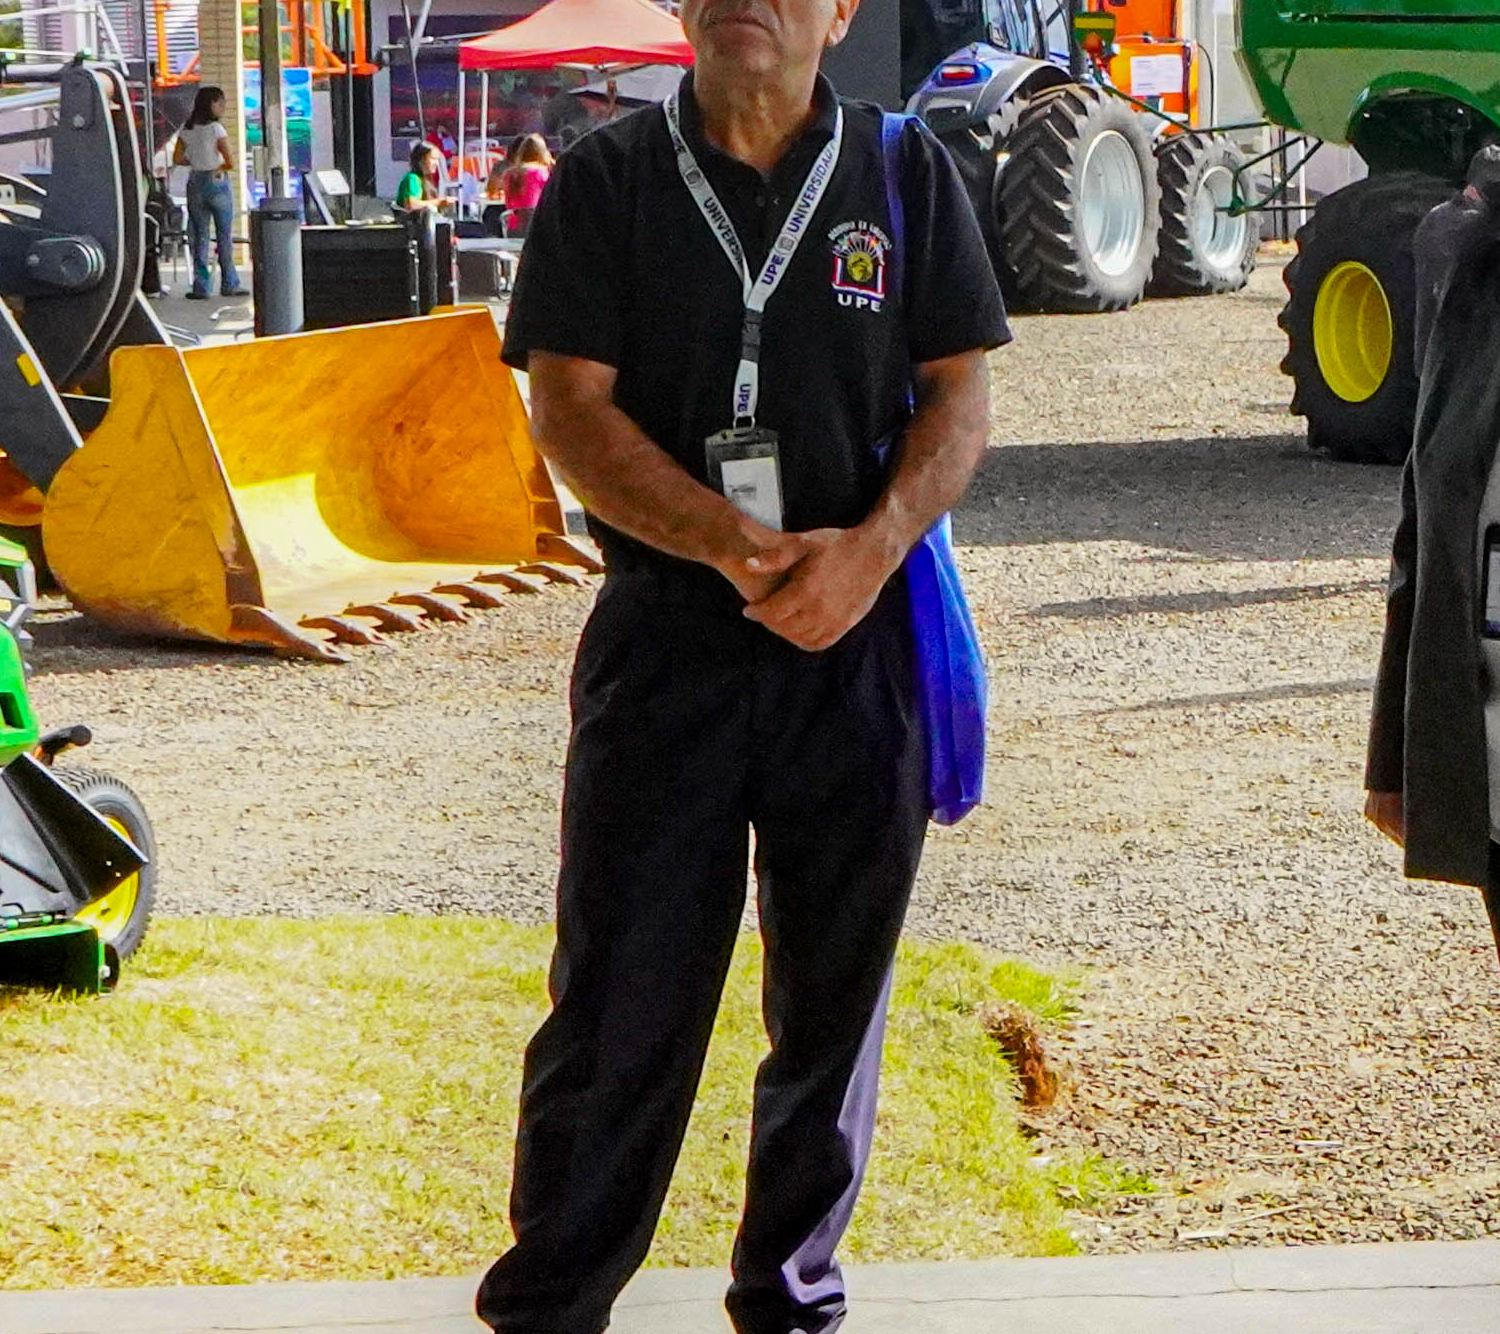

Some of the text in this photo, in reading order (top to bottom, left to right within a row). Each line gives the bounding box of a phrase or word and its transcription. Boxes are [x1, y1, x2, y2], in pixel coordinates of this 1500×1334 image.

[762, 254, 785, 285] UPE
[838, 293, 881, 312] UPE
[737, 383, 751, 412] UPE
